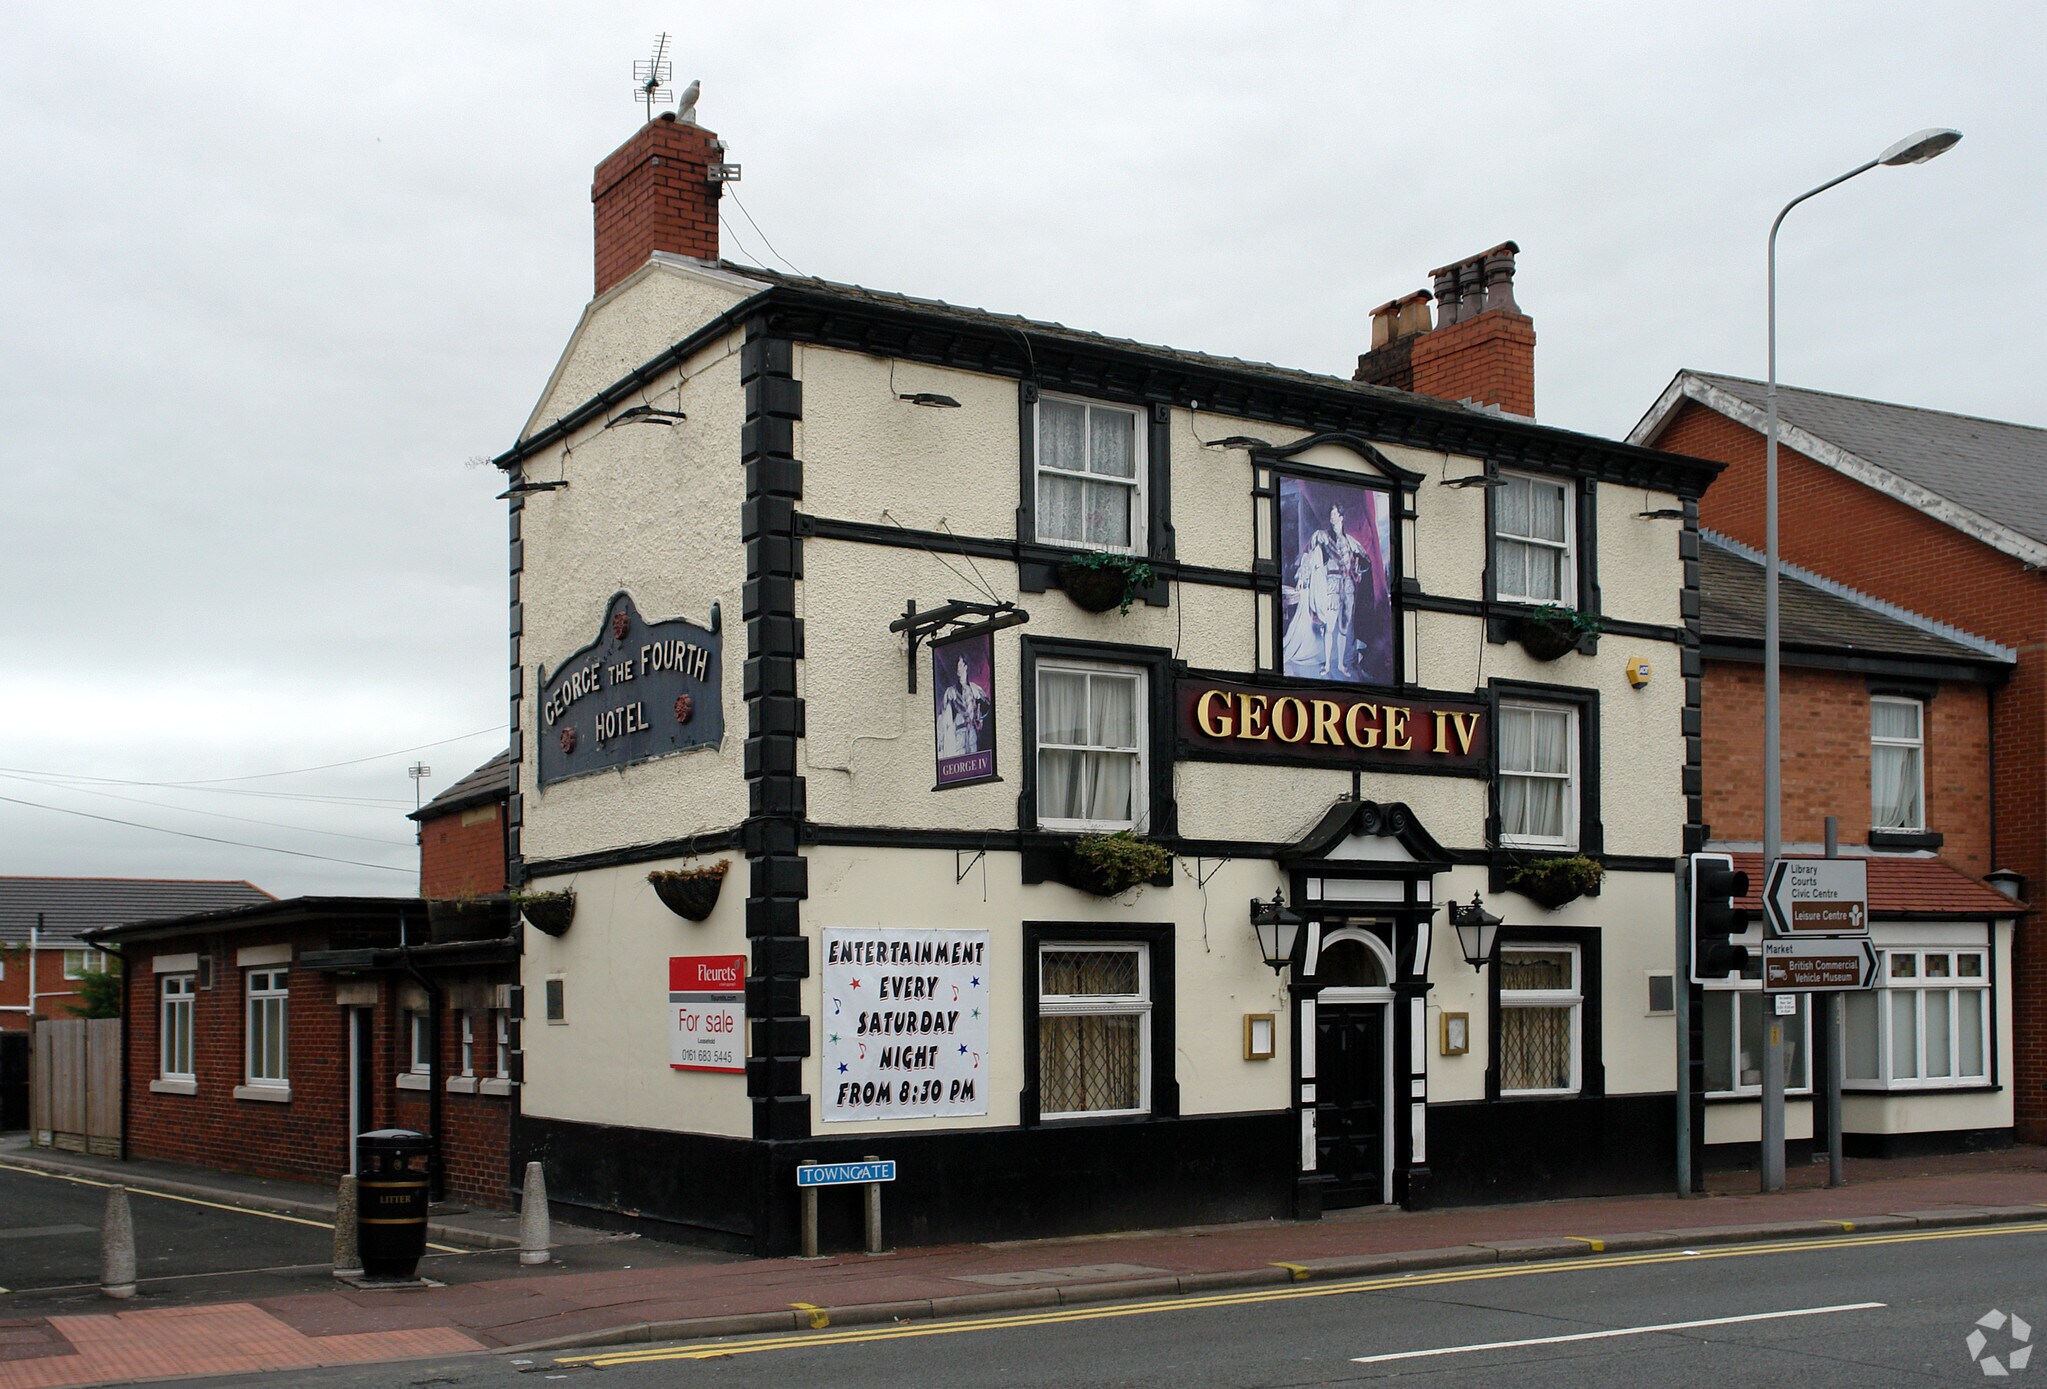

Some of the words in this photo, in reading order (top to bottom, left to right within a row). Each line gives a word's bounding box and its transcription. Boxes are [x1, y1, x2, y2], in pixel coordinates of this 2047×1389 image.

[544, 662, 600, 727] GEORGE
[608, 660, 633, 686] THE
[641, 640, 709, 683] FOURTH
[595, 702, 649, 742] HOTEL
[1197, 689, 1413, 751] GEORGE
[1432, 709, 1480, 756] IV
[942, 758, 977, 776] GEORGE
[978, 757, 988, 770] IV
[1791, 864, 1817, 875] Library
[1791, 876, 1817, 886] Courts
[1792, 889, 1810, 898] Civic
[1813, 889, 1838, 898] Centre
[1794, 910, 1820, 920] Leisure
[1822, 910, 1847, 920] Centre
[828, 941, 984, 965] ENTERTAINMENT
[1766, 944, 1793, 954] Market
[697, 964, 737, 981] Fleurets
[1789, 960, 1813, 971] British
[1815, 960, 1858, 970] Commercial
[1795, 972, 1820, 983] Vehicle
[1823, 972, 1853, 982] Museum
[879, 976, 940, 1000] EVERY
[678, 1009, 700, 1032] For
[705, 1009, 734, 1033] sale
[857, 1011, 960, 1036] SATURDAY
[682, 1049, 696, 1061] 0161
[698, 1049, 711, 1062] 683
[714, 1050, 732, 1063] 5445
[879, 1045, 939, 1071] NIGHT
[836, 1081, 893, 1107] FROM
[899, 1079, 943, 1105] 8:30
[949, 1078, 976, 1103] PM
[803, 1164, 889, 1182] TOWNGATE
[379, 1194, 411, 1204] LITTER
